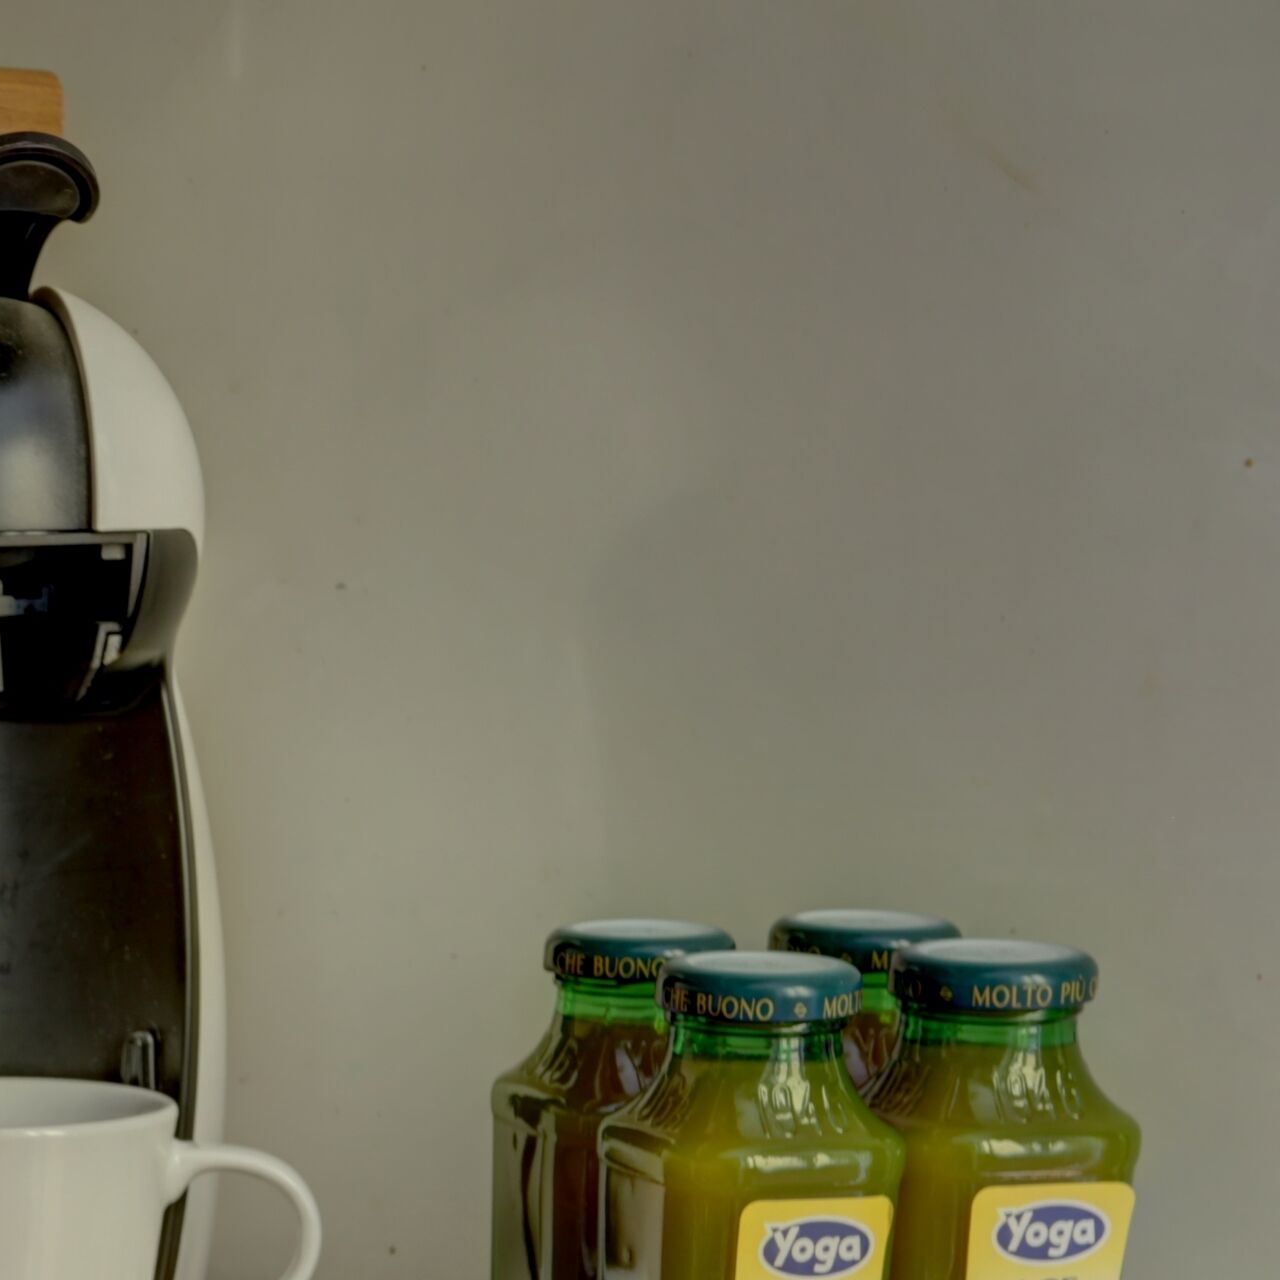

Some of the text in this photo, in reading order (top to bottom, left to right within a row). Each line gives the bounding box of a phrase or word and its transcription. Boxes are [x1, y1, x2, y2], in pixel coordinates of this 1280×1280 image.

[558, 951, 584, 976] CHE
[696, 996, 774, 1021] BUONO
[972, 983, 1053, 1009] MOLTO
[1060, 977, 1085, 1005] PIÙ
[770, 1224, 862, 1274] Yoga
[1003, 1210, 1096, 1258] Yoga
